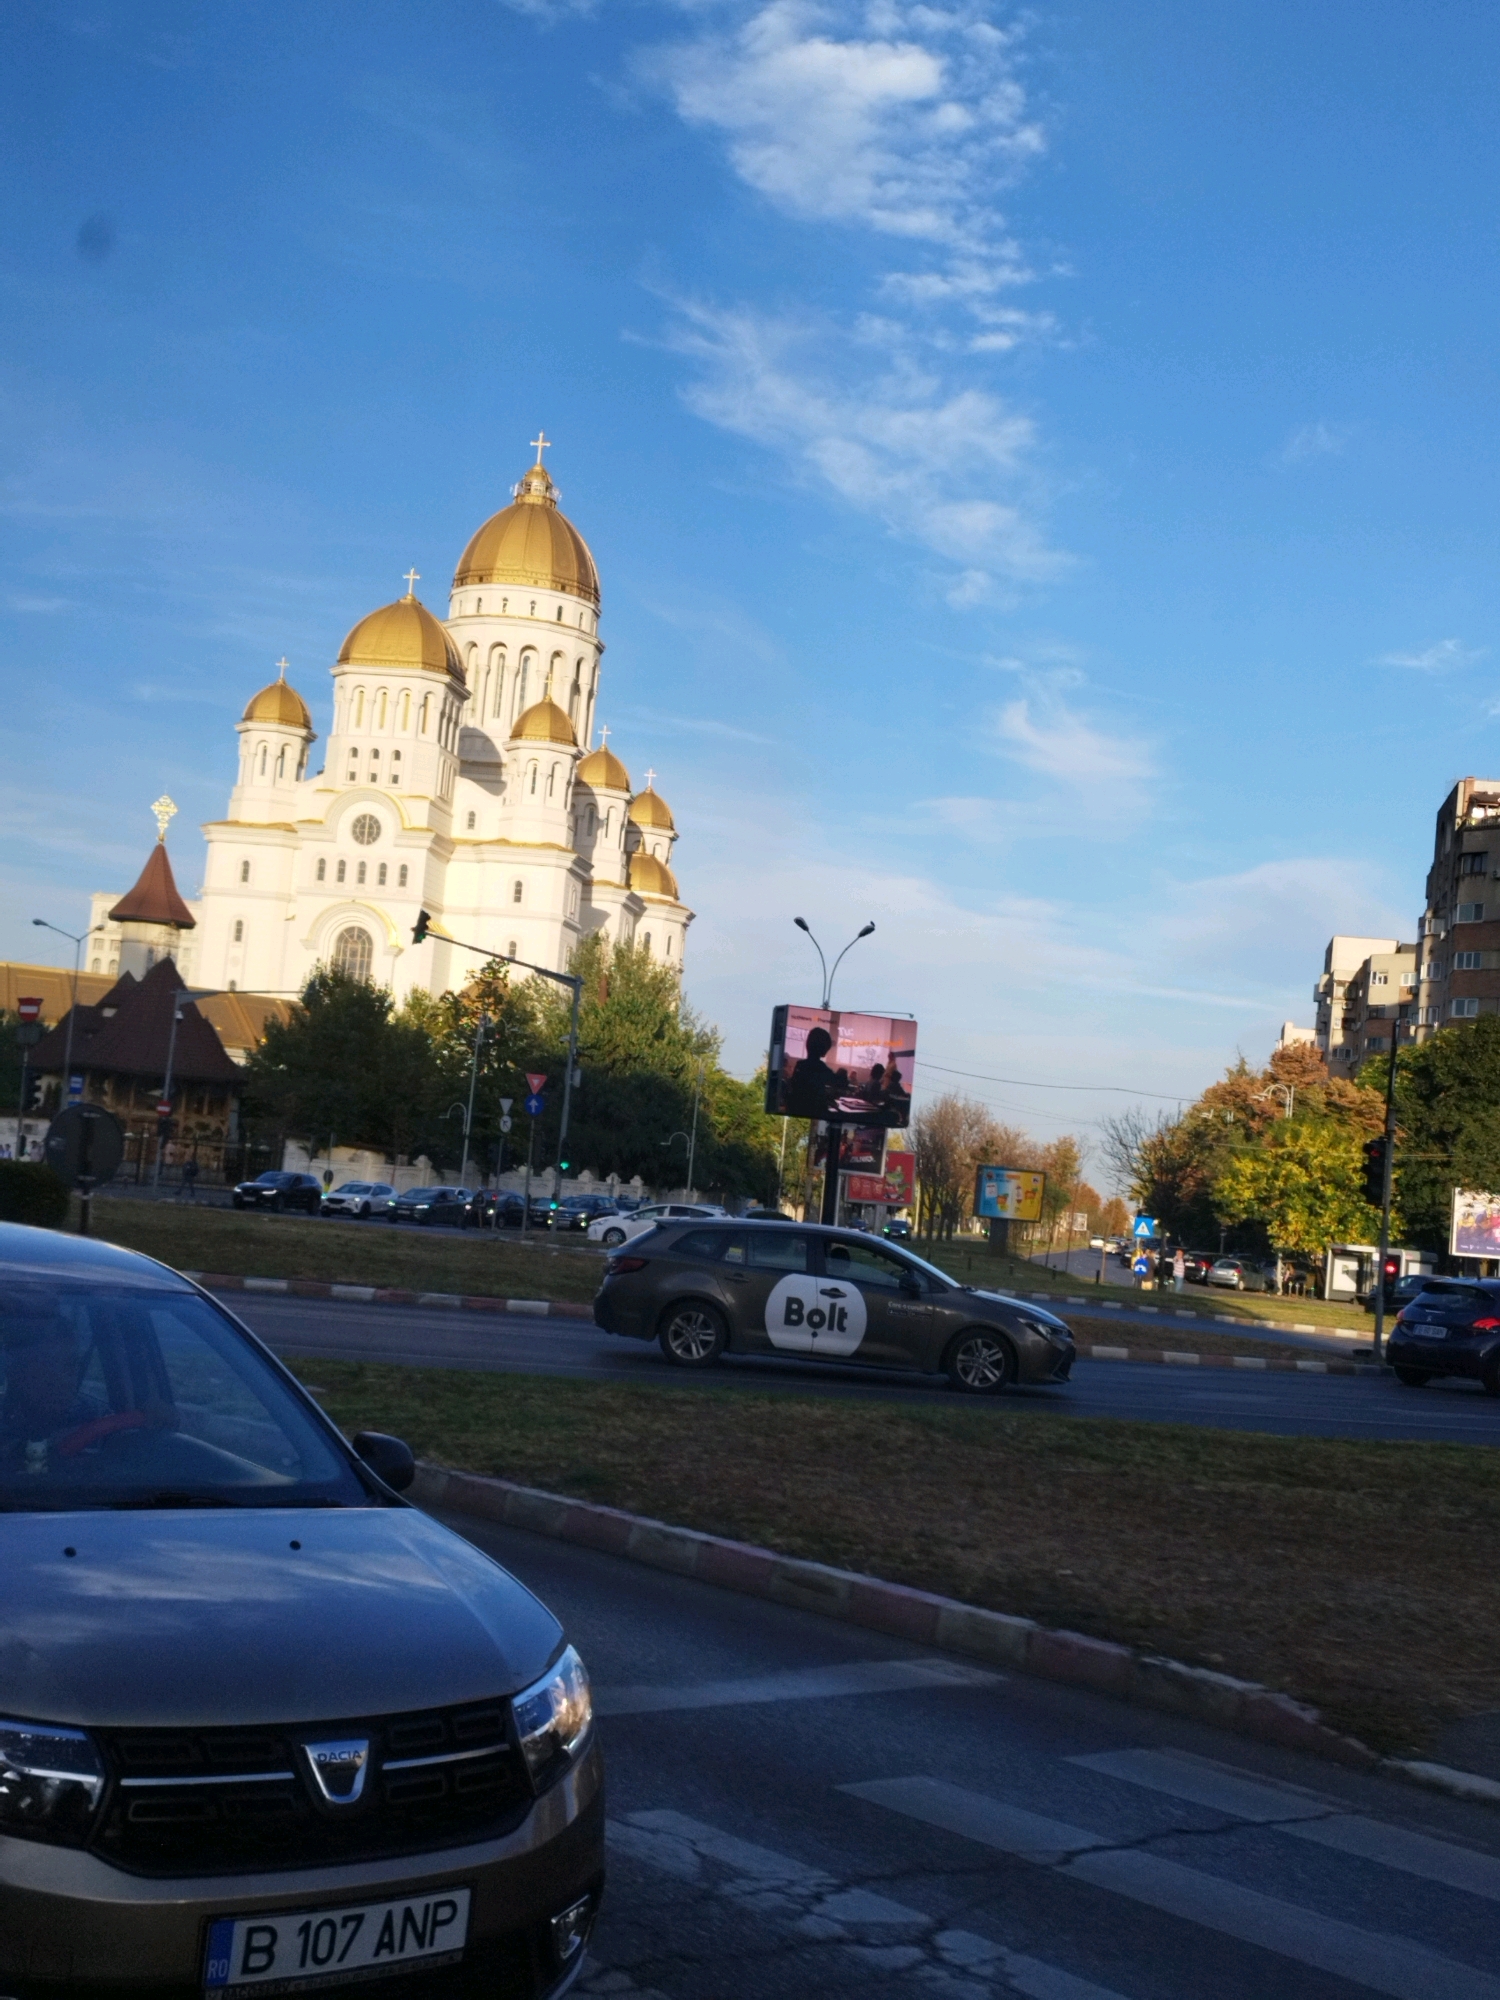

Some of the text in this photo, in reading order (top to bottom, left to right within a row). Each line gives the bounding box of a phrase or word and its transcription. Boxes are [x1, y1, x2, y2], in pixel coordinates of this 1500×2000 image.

[784, 1296, 848, 1332] Bolt
[317, 1749, 362, 1762] DACIA
[241, 1924, 278, 1976] B
[297, 1912, 365, 1968] 107
[373, 1899, 458, 1957] ANP
[207, 1958, 228, 1979] RO
